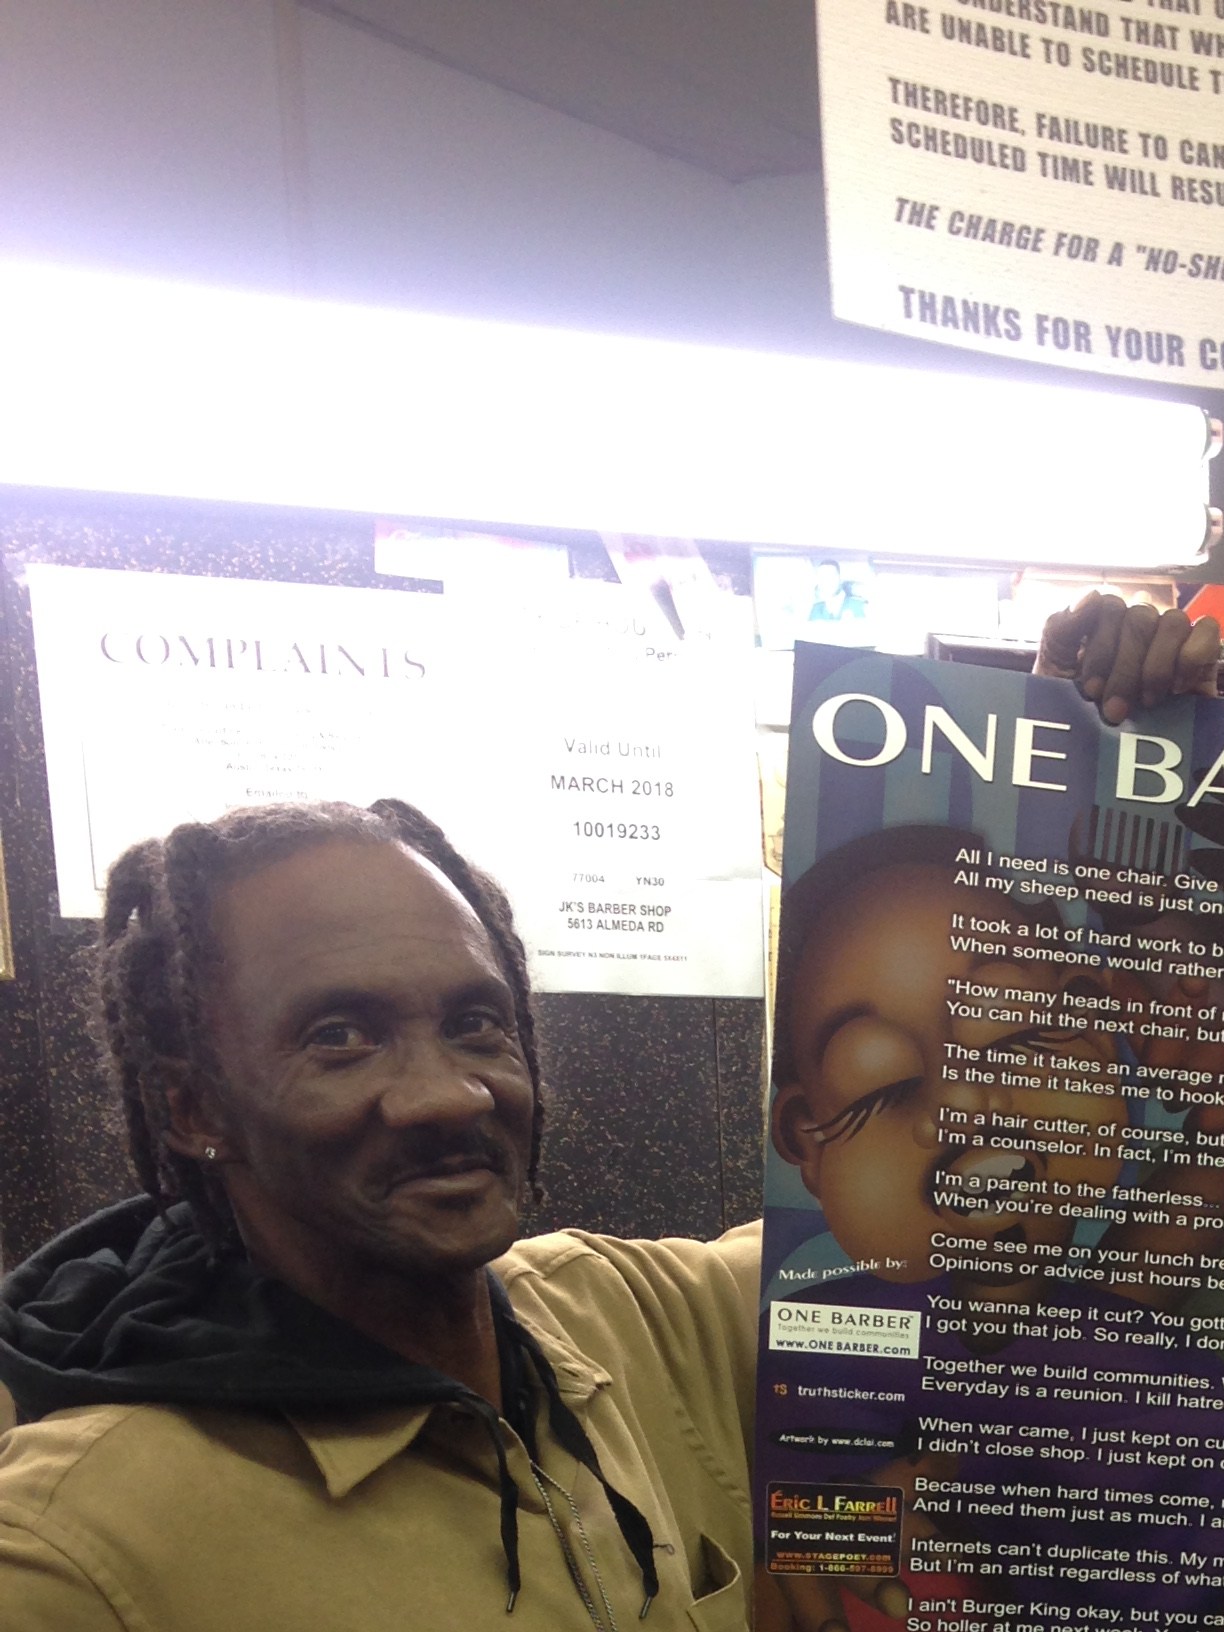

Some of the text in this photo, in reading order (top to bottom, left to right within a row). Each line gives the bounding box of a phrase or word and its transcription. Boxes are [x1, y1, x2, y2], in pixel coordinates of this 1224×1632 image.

[885, 0, 931, 35] ARE
[940, 13, 1032, 60] UNABLE
[1041, 38, 1071, 68] TO
[1082, 46, 1200, 92] SCHEDULE
[1120, 17, 1180, 51] THAT
[887, 76, 1026, 137] THEREFORE,
[1035, 111, 1129, 155] FAILURE
[1140, 131, 1169, 161] TO
[889, 118, 1027, 173] SCHEDULED
[1037, 152, 1095, 187] TIME
[1104, 164, 1160, 198] WILL
[894, 196, 939, 232] THE
[947, 215, 1046, 253] CHARGE
[1054, 232, 1101, 263] FOR
[1106, 241, 1125, 267] A
[898, 284, 1023, 343] THANKS
[1034, 312, 1094, 355] FOR
[1104, 324, 1186, 368] YOUR
[100, 632, 427, 680] COMPLAINTS
[563, 737, 662, 759] Valid Until
[811, 692, 1072, 794] ONE
[551, 774, 675, 798] MARCH 2018
[572, 821, 662, 841] 10019233
[955, 848, 981, 865] All
[987, 852, 993, 866] I
[999, 853, 1048, 873] need
[1053, 859, 1070, 876] is
[1075, 864, 1111, 881] one
[1116, 867, 1168, 888] chair.
[1174, 873, 1218, 893] Give
[558, 901, 672, 917] JK'S BARBER SHOP
[567, 917, 665, 933] 5613 ALMEDA RD
[937, 1127, 967, 1145] I'm
[972, 1132, 985, 1147] a
[990, 1133, 1087, 1156] counselor.
[1094, 1142, 1111, 1158] In
[1117, 1144, 1156, 1163] fact,
[1163, 1149, 1191, 1166] I'm
[779, 1269, 817, 1282] Made
[822, 1259, 880, 1280] possible
[777, 1307, 912, 1330] ONE BARBER
[923, 1355, 1005, 1377] Together
[1010, 1363, 1037, 1378] we
[1043, 1363, 1088, 1381] build
[1093, 1368, 1215, 1392] communities.
[797, 1385, 906, 1402] truthsticker.com
[816, 1494, 829, 1511] L
[770, 1530, 791, 1540] For
[793, 1531, 822, 1541] Your
[824, 1532, 854, 1542] Next
[911, 1537, 1173, 1566] Internets can't duplicate this.
